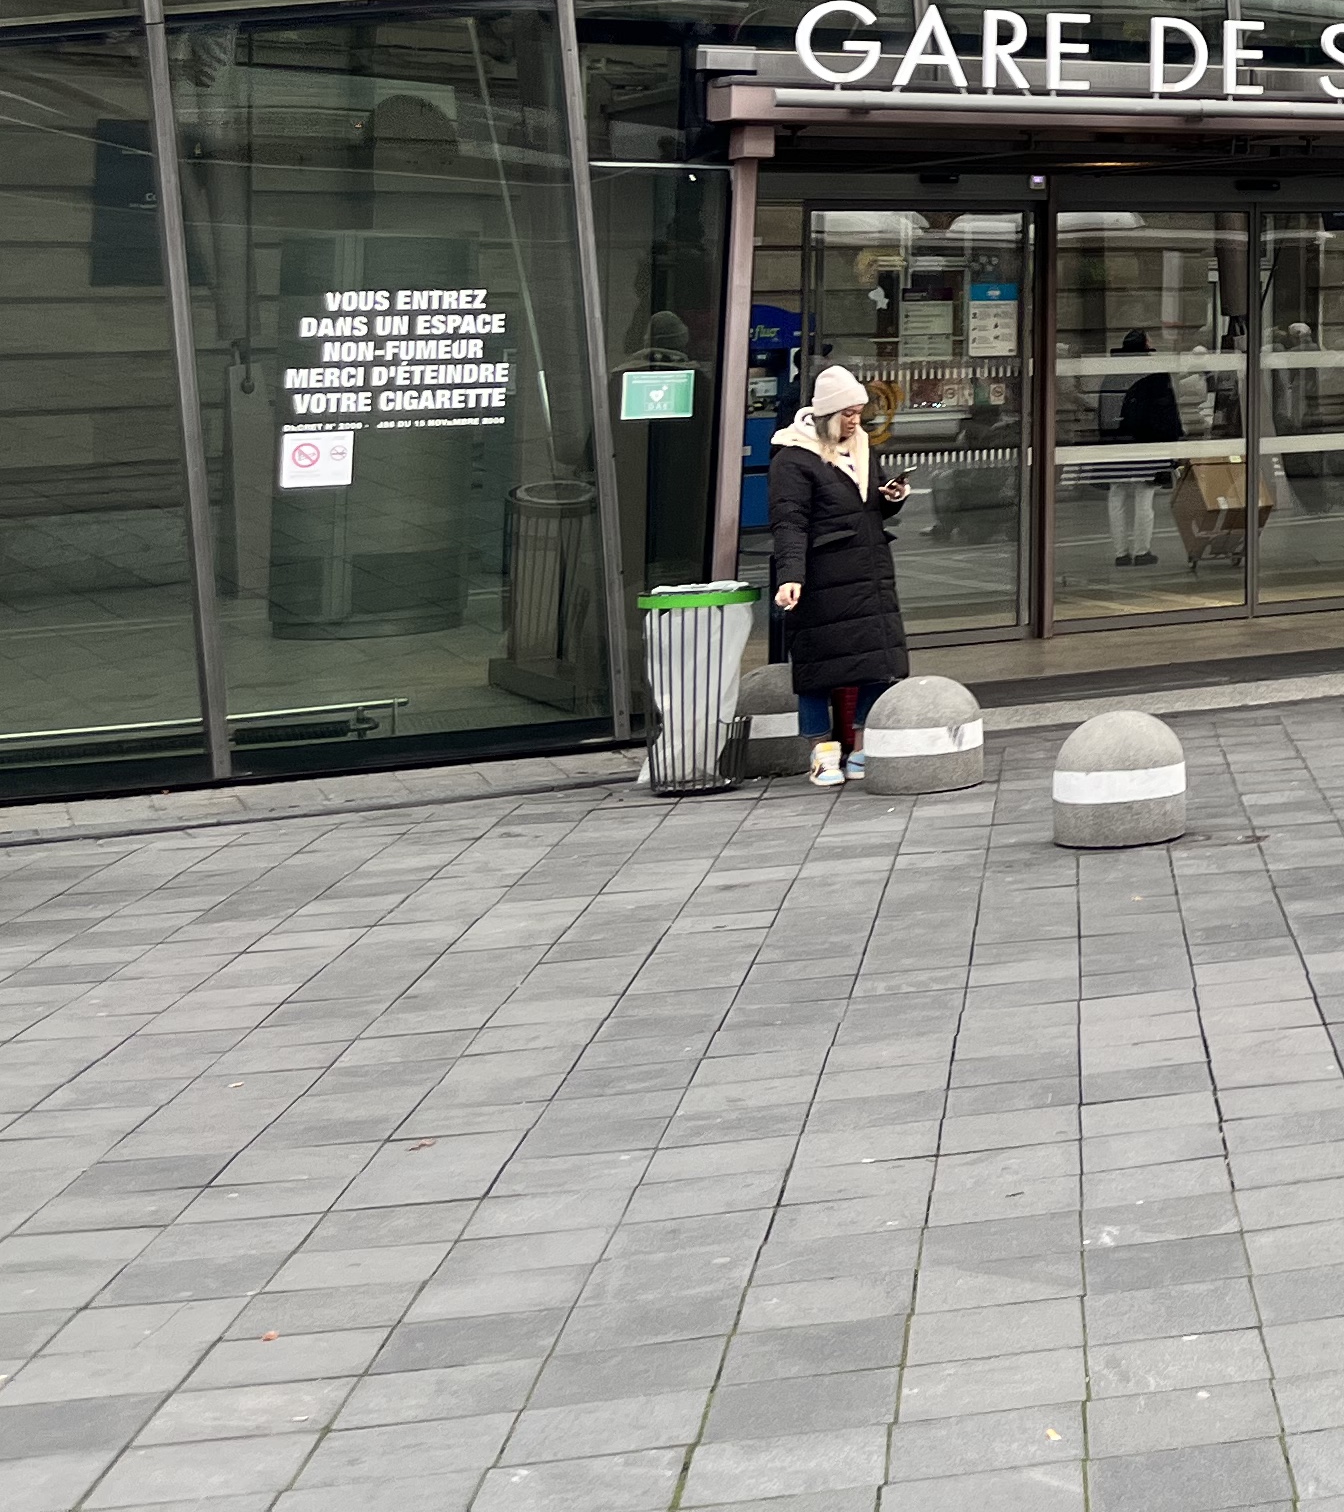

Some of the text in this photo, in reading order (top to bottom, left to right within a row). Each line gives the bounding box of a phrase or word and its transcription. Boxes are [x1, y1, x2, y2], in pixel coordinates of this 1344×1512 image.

[795, 0, 1091, 90] GARE
[1150, 17, 1264, 95] DE
[326, 289, 487, 311] VOUS ENTREZ
[300, 314, 506, 337] DANS UN ESPACE
[323, 339, 483, 362] NON-FUMEUR
[285, 362, 509, 388] MERCI D'ÉTEINDRE
[293, 388, 506, 414] VOTRE CIGARETTE
